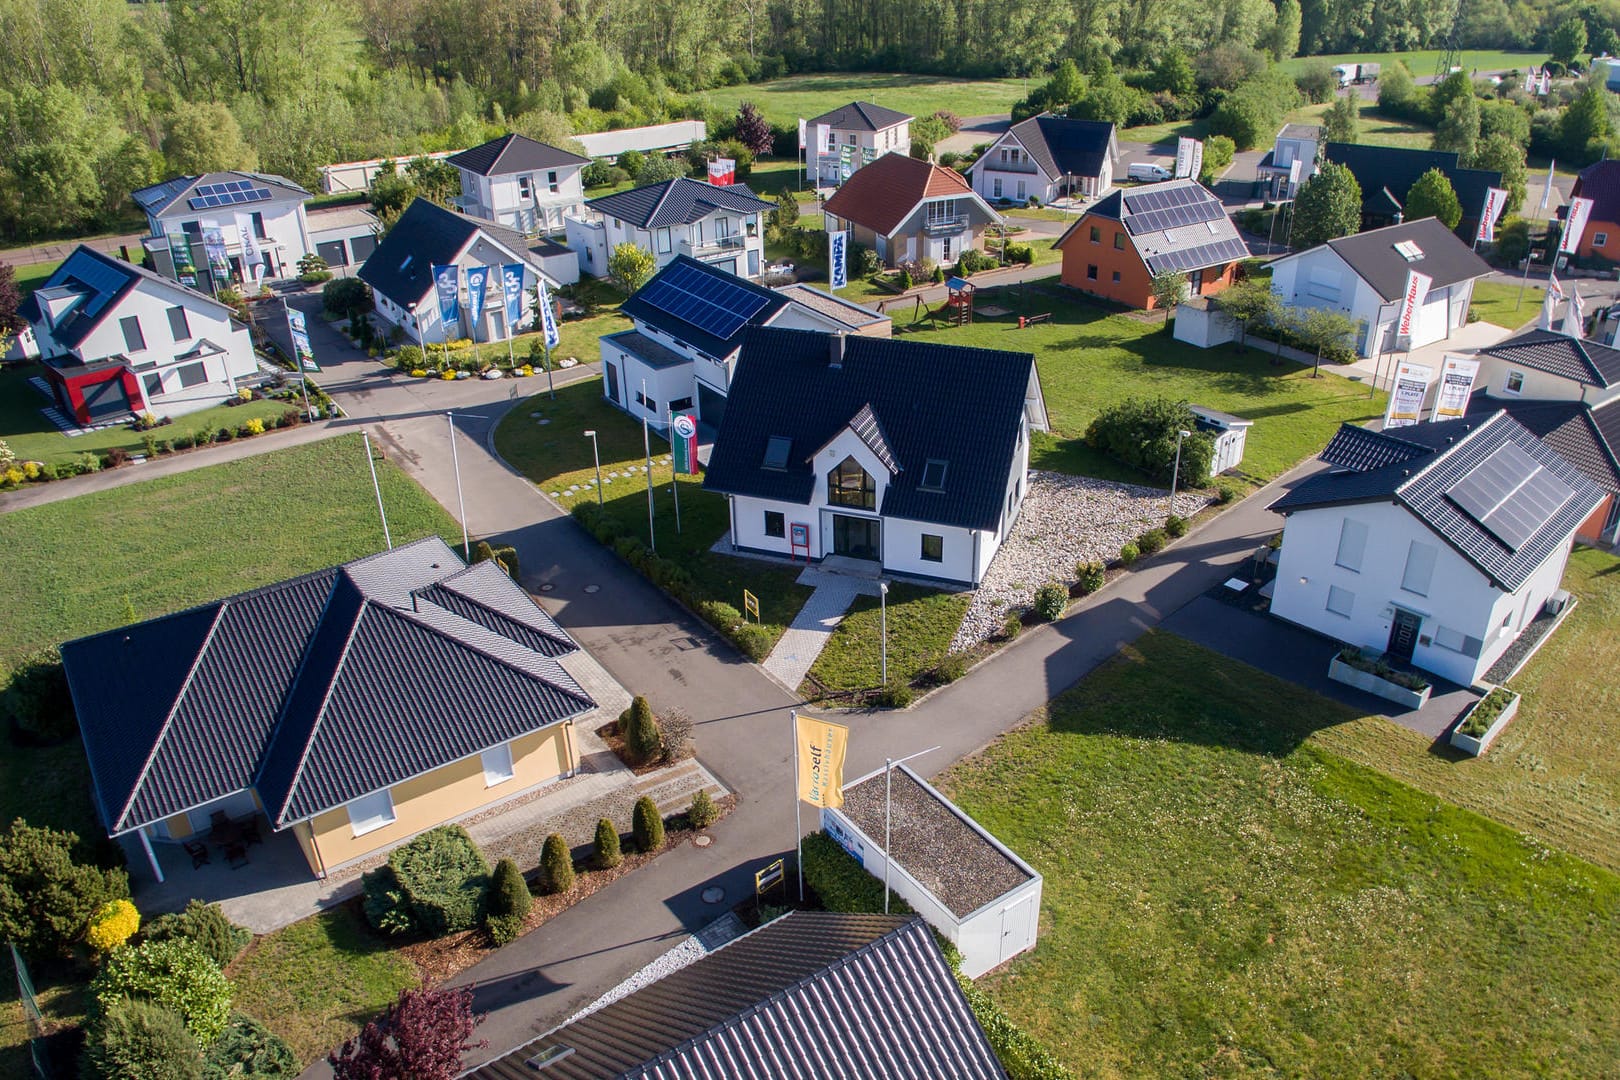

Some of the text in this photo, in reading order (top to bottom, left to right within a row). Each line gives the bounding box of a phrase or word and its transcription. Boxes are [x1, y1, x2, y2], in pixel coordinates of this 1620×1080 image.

[241, 226, 254, 256] OKAL
[833, 234, 844, 287] KAMPA
[438, 272, 458, 294] 35
[505, 271, 520, 292] 35
[1400, 275, 1418, 335] WeberHaus
